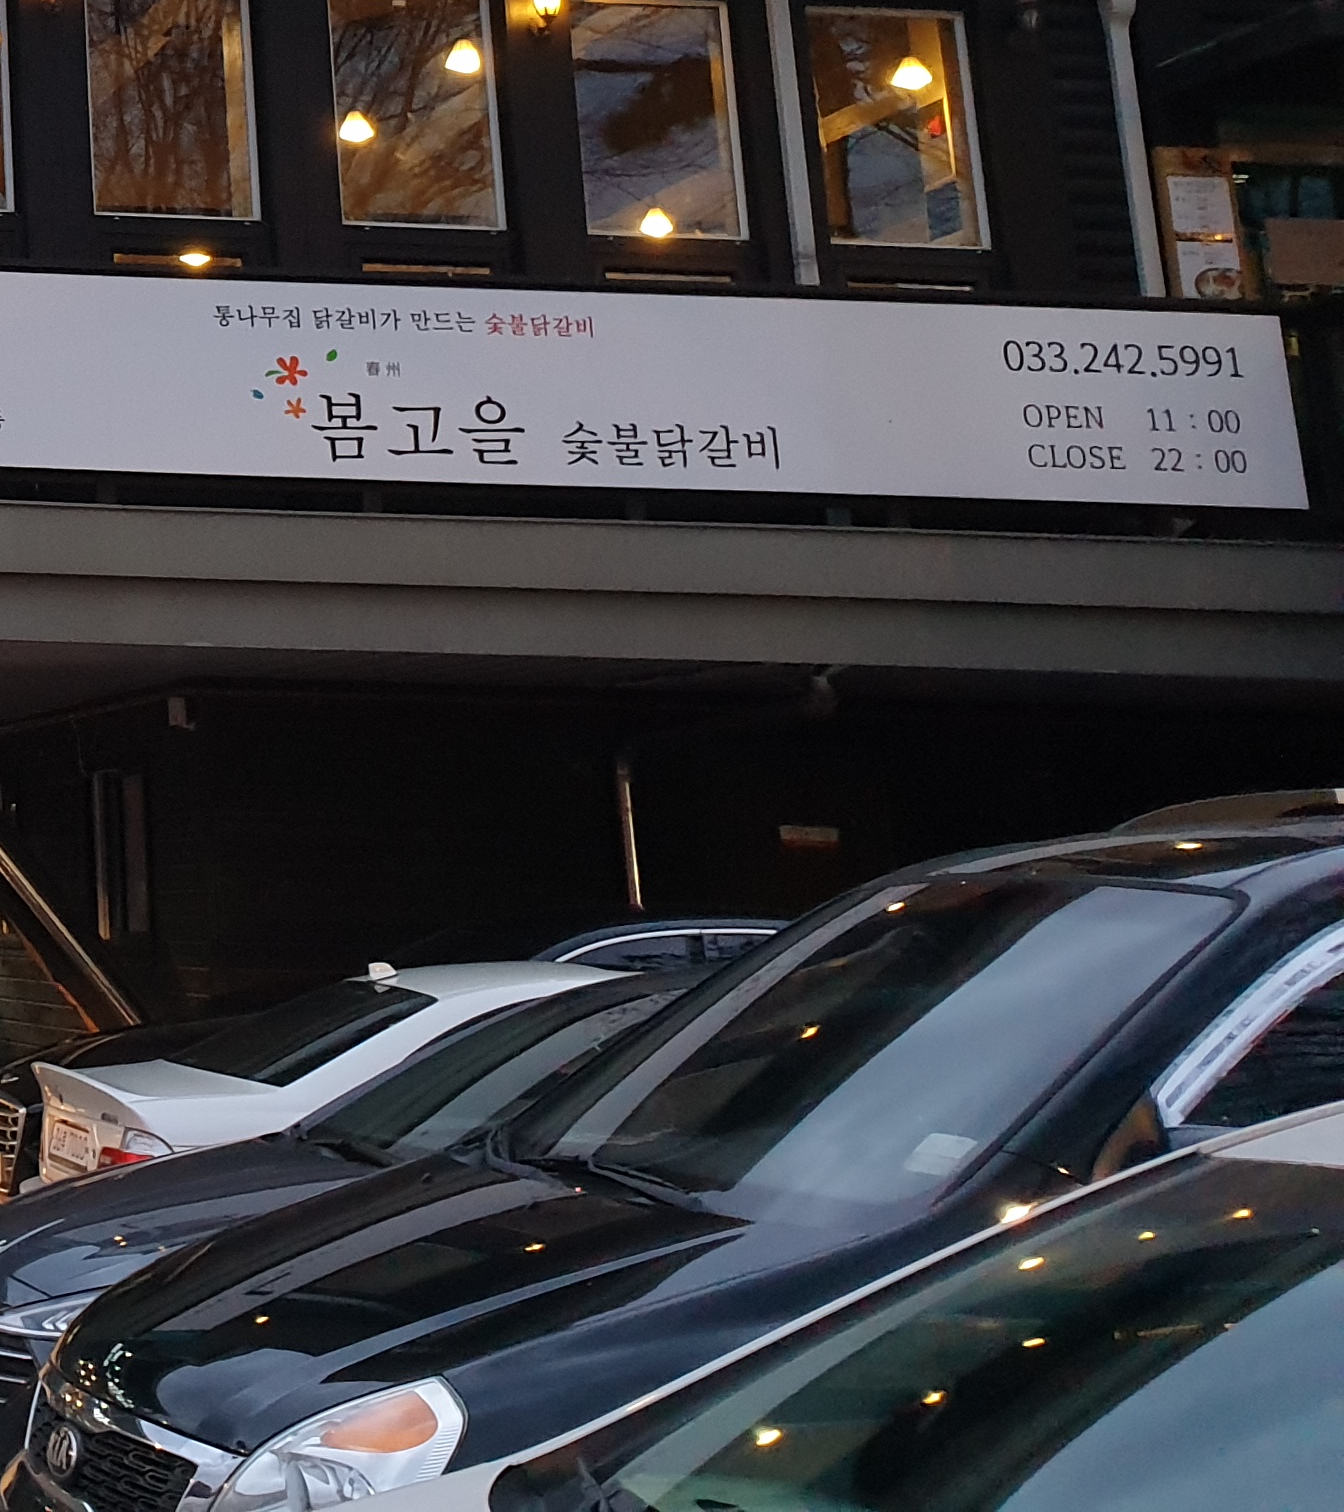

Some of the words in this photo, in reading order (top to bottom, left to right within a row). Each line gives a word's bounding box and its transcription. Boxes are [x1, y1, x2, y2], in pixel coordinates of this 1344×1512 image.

[212, 304, 302, 330] 통나무집
[311, 308, 402, 333] 닭갈비가
[409, 310, 477, 334] 만드는
[484, 313, 595, 339] 숯불닭갈비
[1002, 339, 1245, 379] 033.242.5991
[310, 391, 527, 466] 봄고을
[560, 419, 781, 471] 숯불닭갈비
[1022, 403, 1105, 431] OPEN
[1027, 443, 1127, 472] CLOSE
